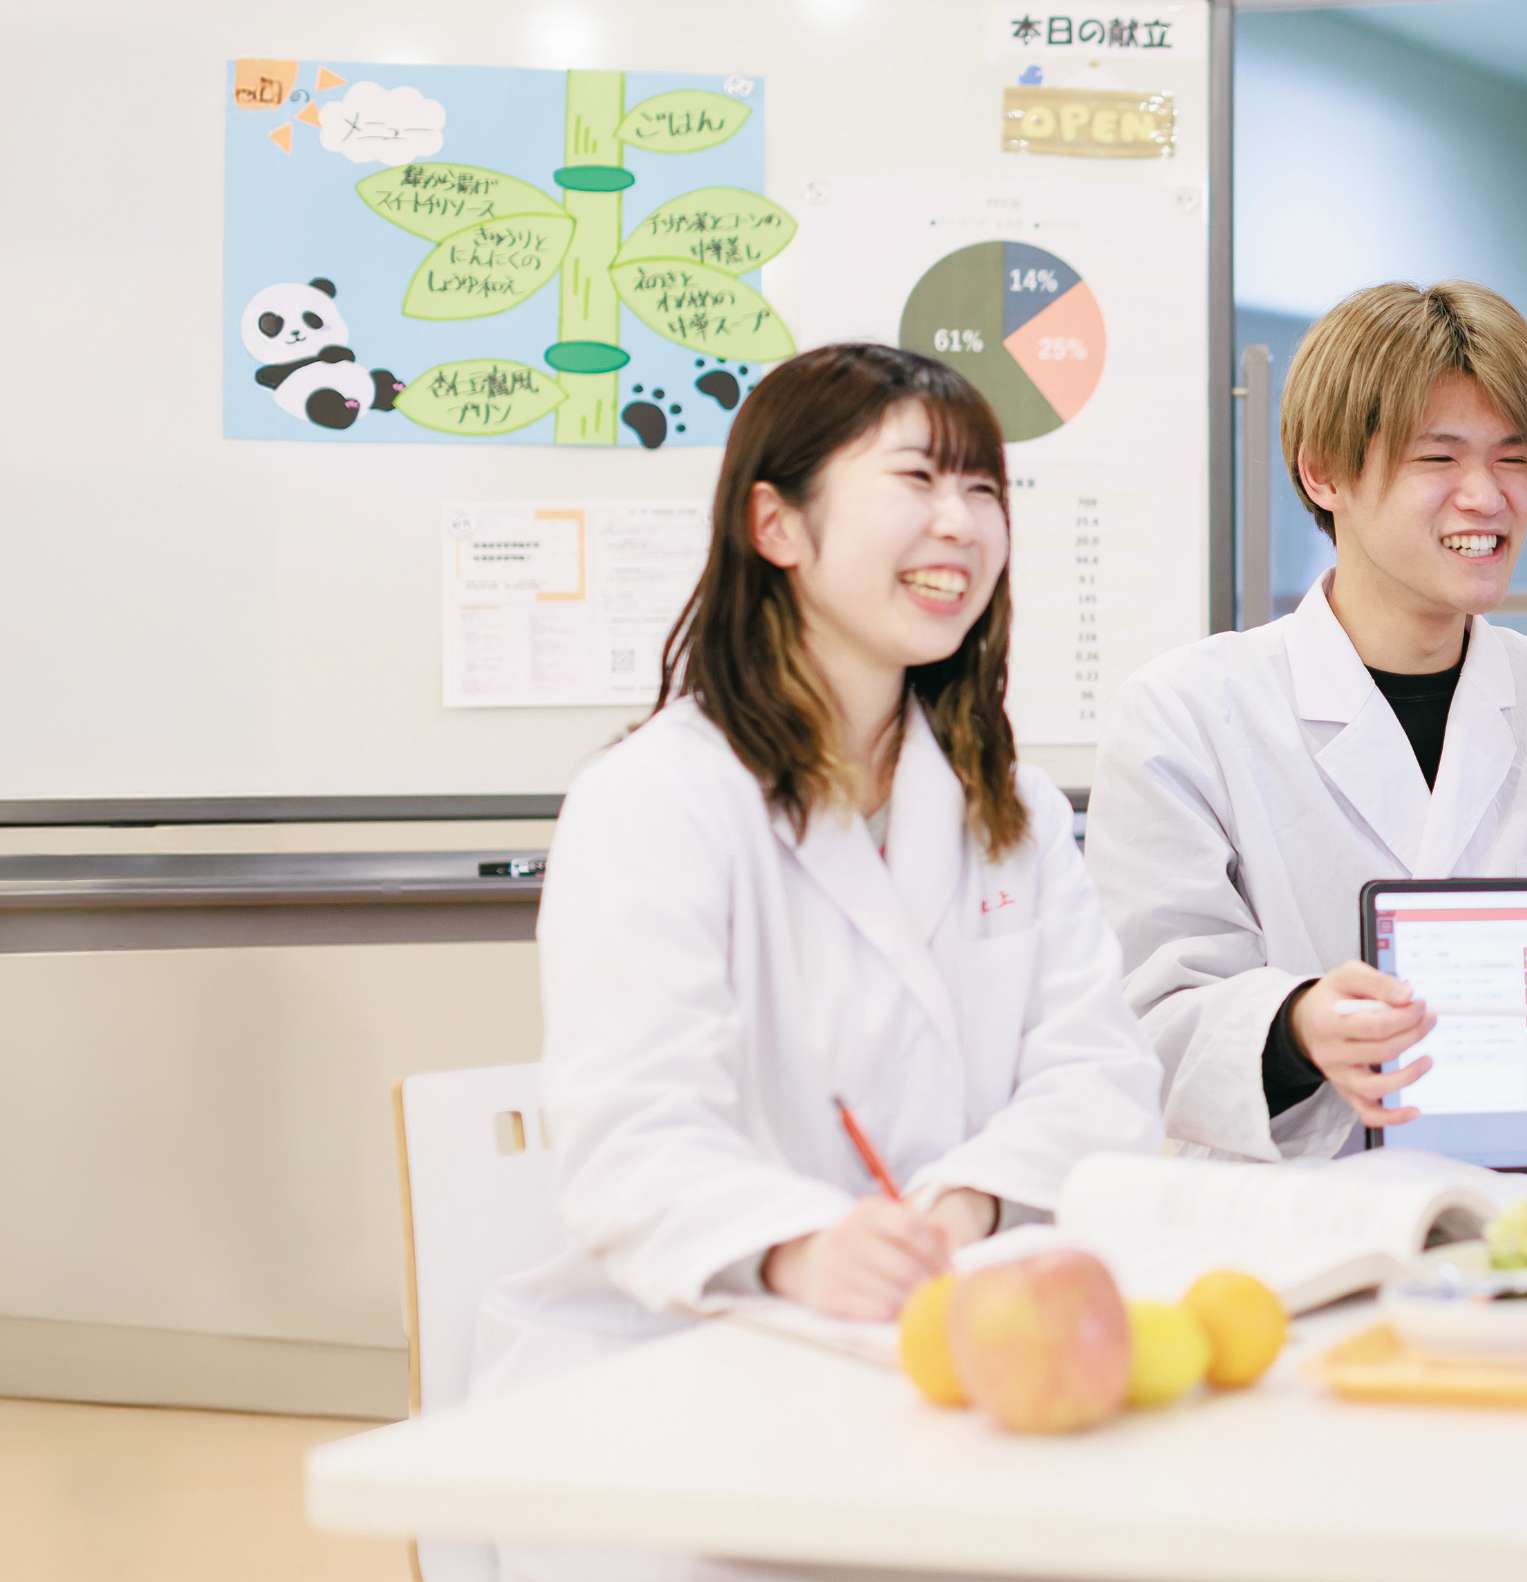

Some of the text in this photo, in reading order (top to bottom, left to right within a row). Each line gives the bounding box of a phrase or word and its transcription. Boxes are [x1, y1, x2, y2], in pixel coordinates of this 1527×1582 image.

[1010, 14, 1173, 49] 本日の献立
[341, 112, 435, 143] メニュー
[635, 110, 726, 139] ごはん
[1020, 104, 1158, 143] OPEN
[449, 245, 542, 271] にんにくの
[1009, 268, 1058, 292] 14%
[933, 328, 984, 353] 61%
[1037, 336, 1088, 361] 25%
[447, 402, 512, 424] プリン
